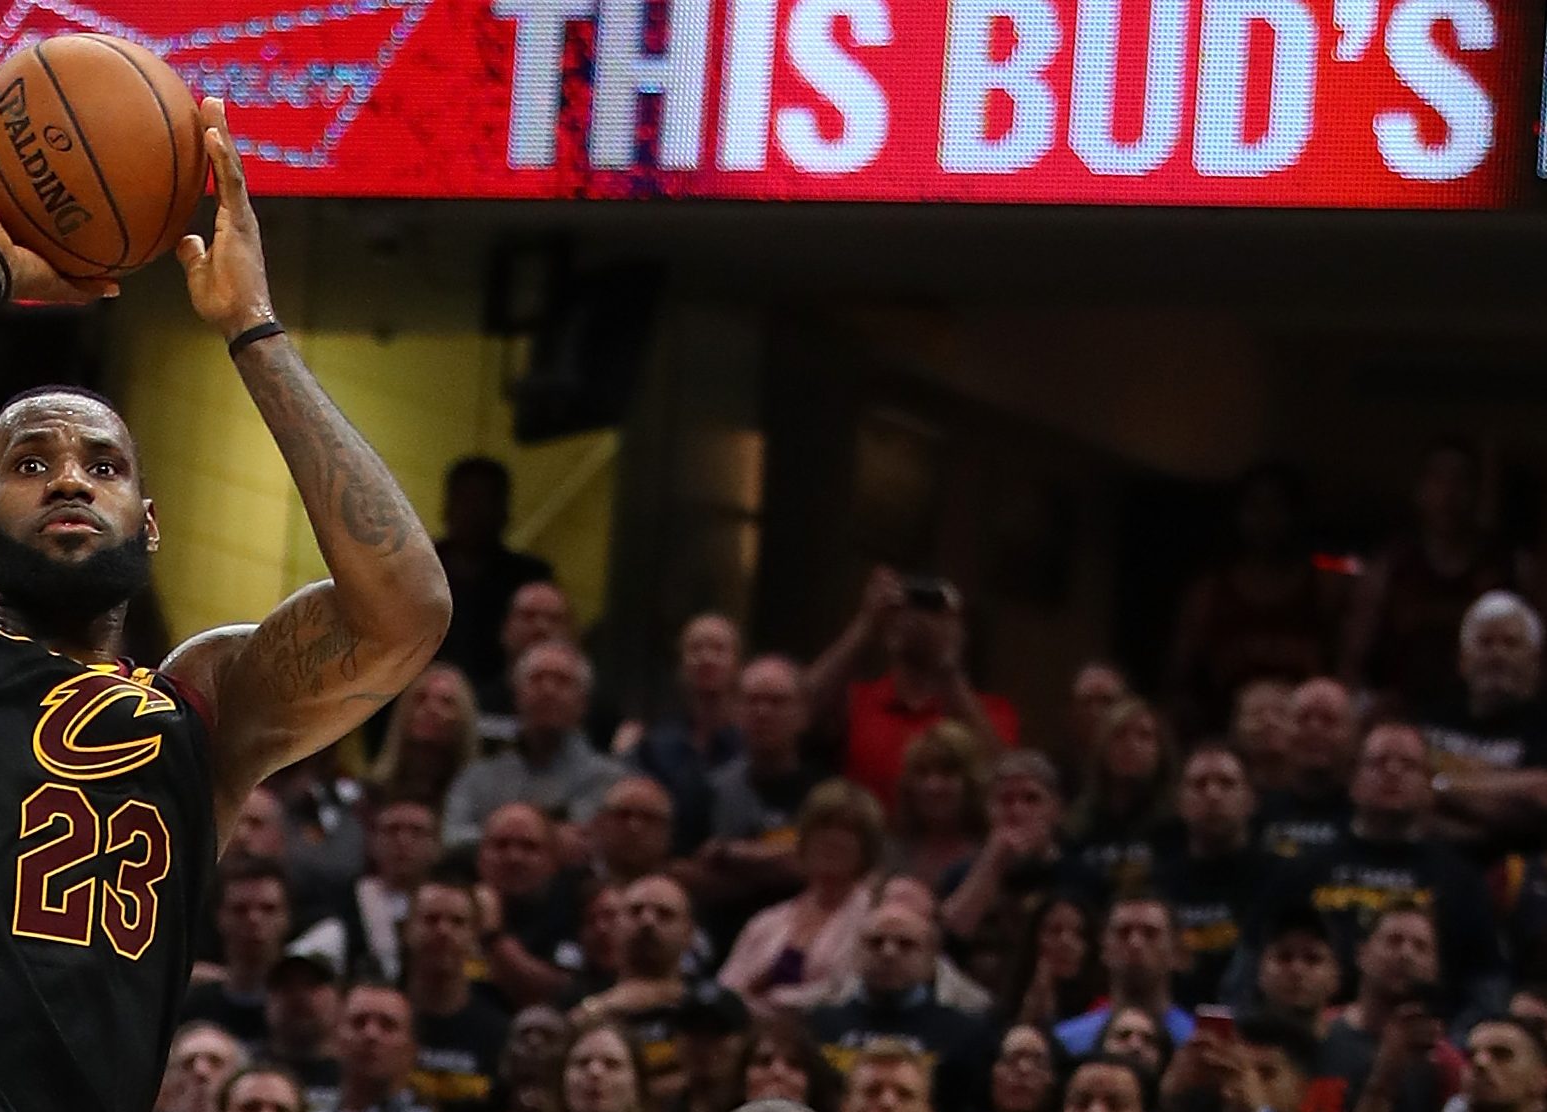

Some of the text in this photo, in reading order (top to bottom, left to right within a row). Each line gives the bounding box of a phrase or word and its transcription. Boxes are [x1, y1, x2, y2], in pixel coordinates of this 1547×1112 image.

[489, 0, 1496, 181] THIS BUD'S
[12, 782, 171, 961] 23
